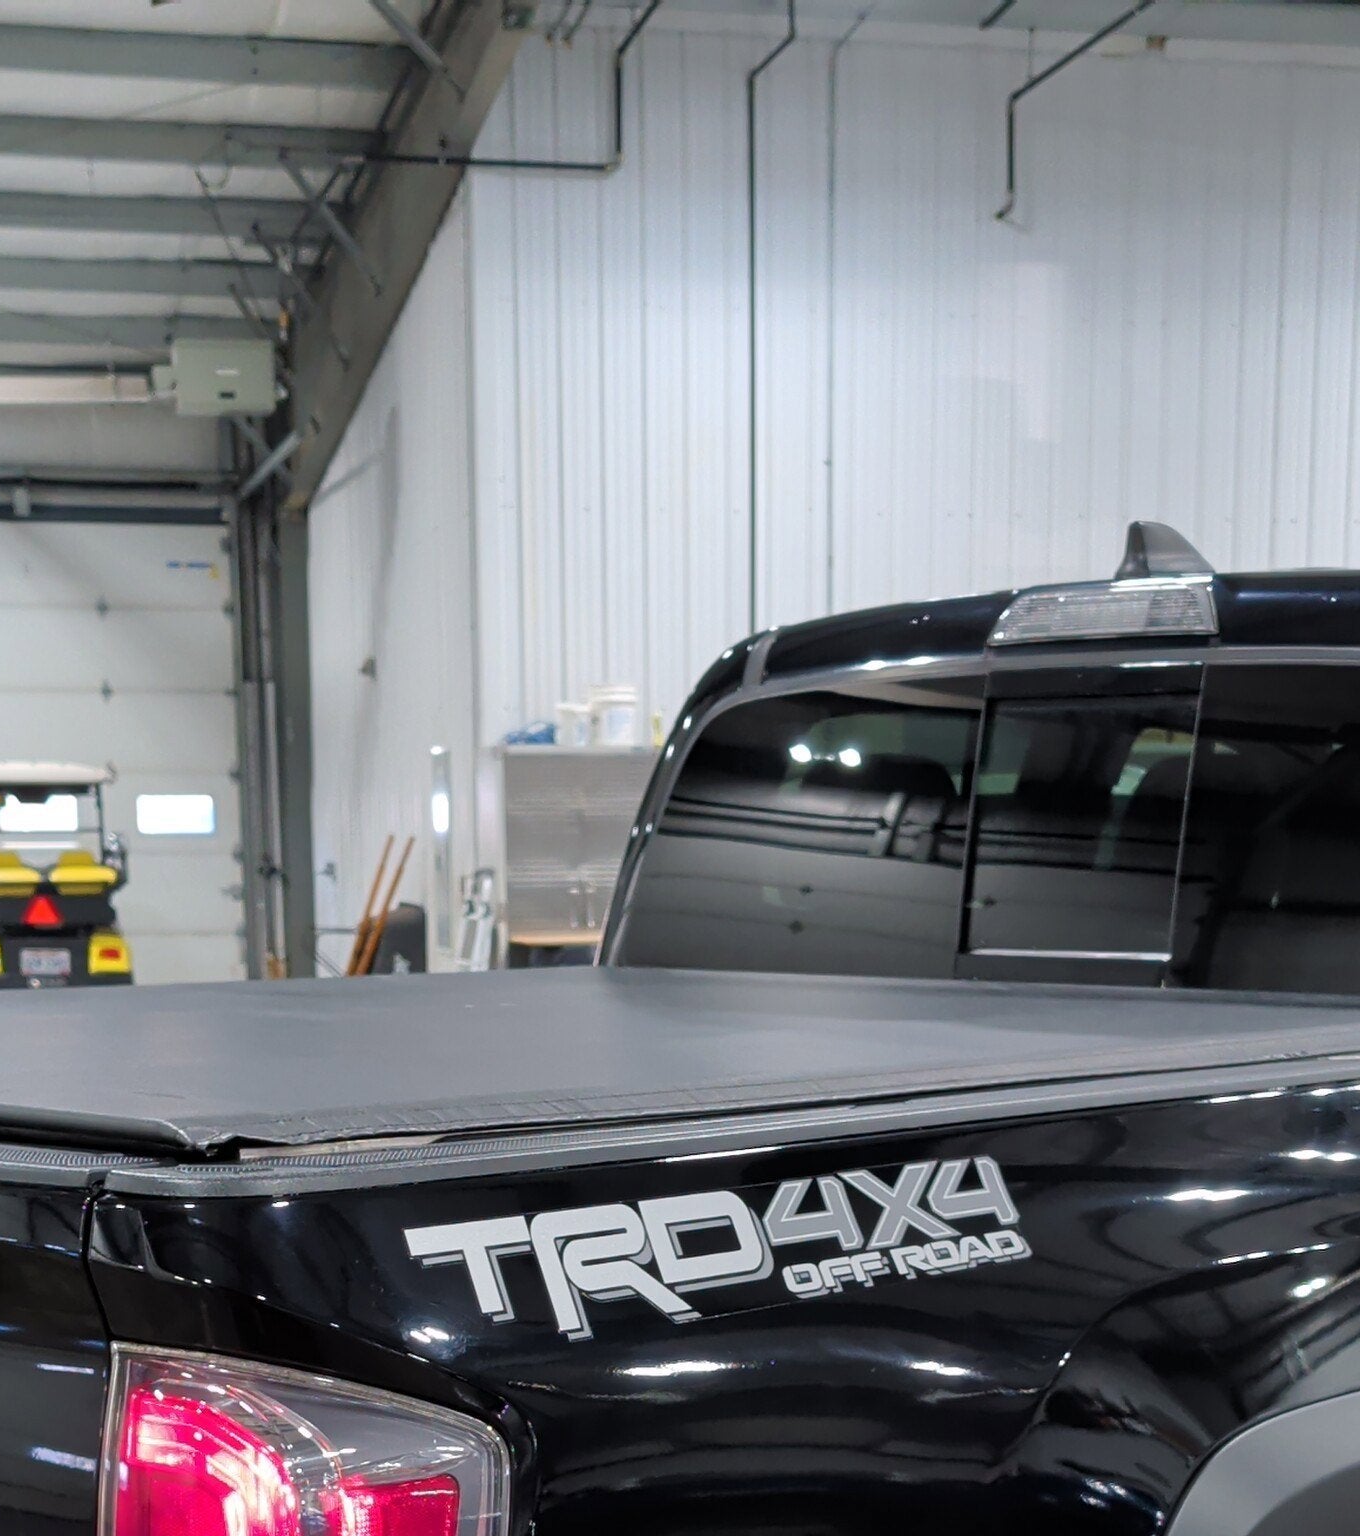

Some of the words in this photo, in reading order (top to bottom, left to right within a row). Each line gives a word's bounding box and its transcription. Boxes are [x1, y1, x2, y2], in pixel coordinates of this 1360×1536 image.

[403, 1189, 774, 1342] TRD
[782, 1251, 891, 1299] OFF
[890, 1229, 1033, 1280] ROAD
